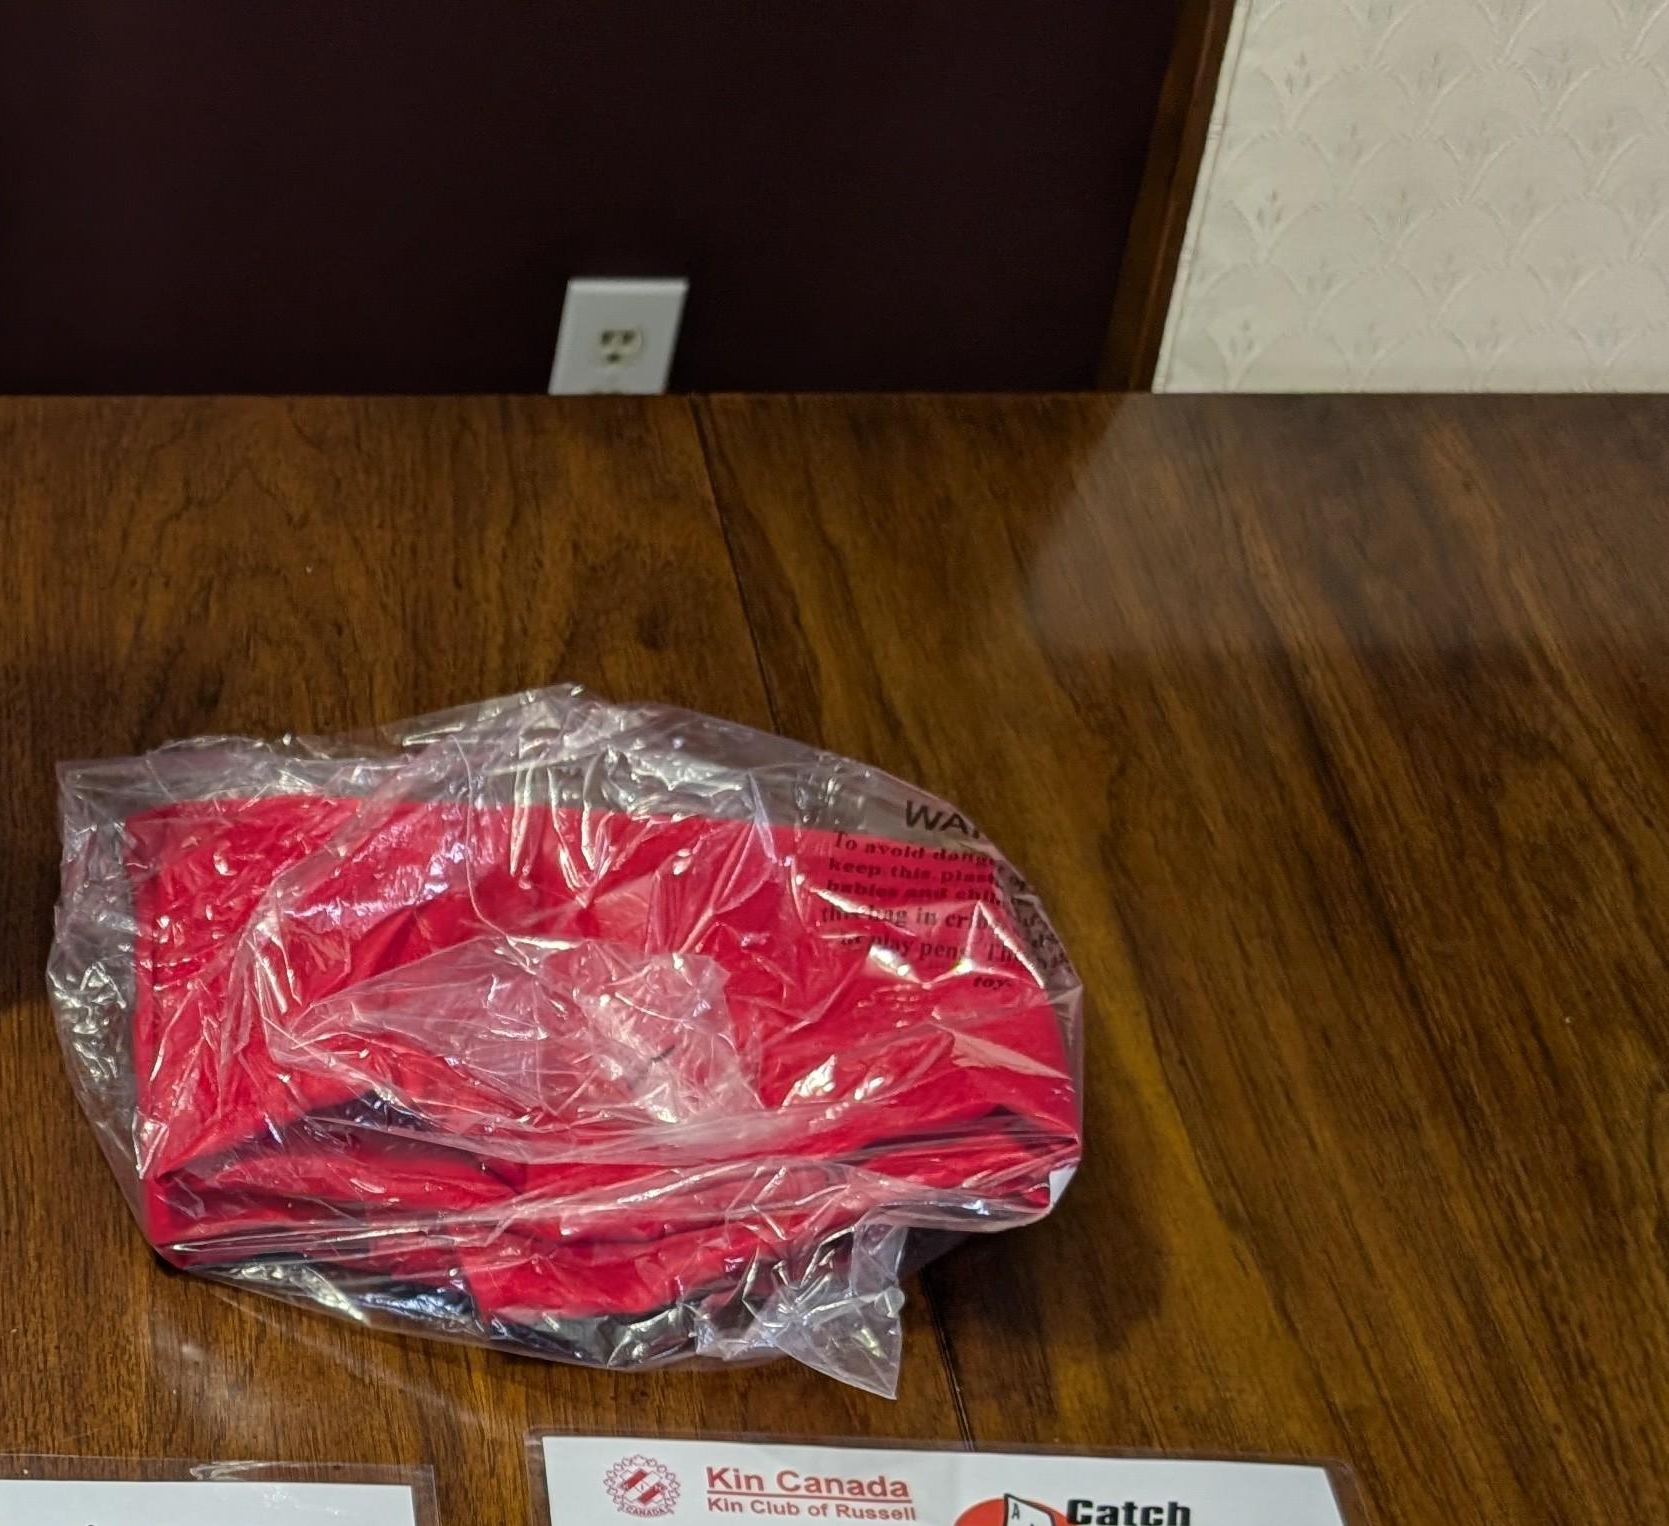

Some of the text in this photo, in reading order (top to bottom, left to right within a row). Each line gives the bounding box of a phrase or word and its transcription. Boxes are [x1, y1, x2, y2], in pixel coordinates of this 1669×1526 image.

[706, 1466, 910, 1499] Kin Canada
[707, 1497, 917, 1521] Kin Club of Russell
